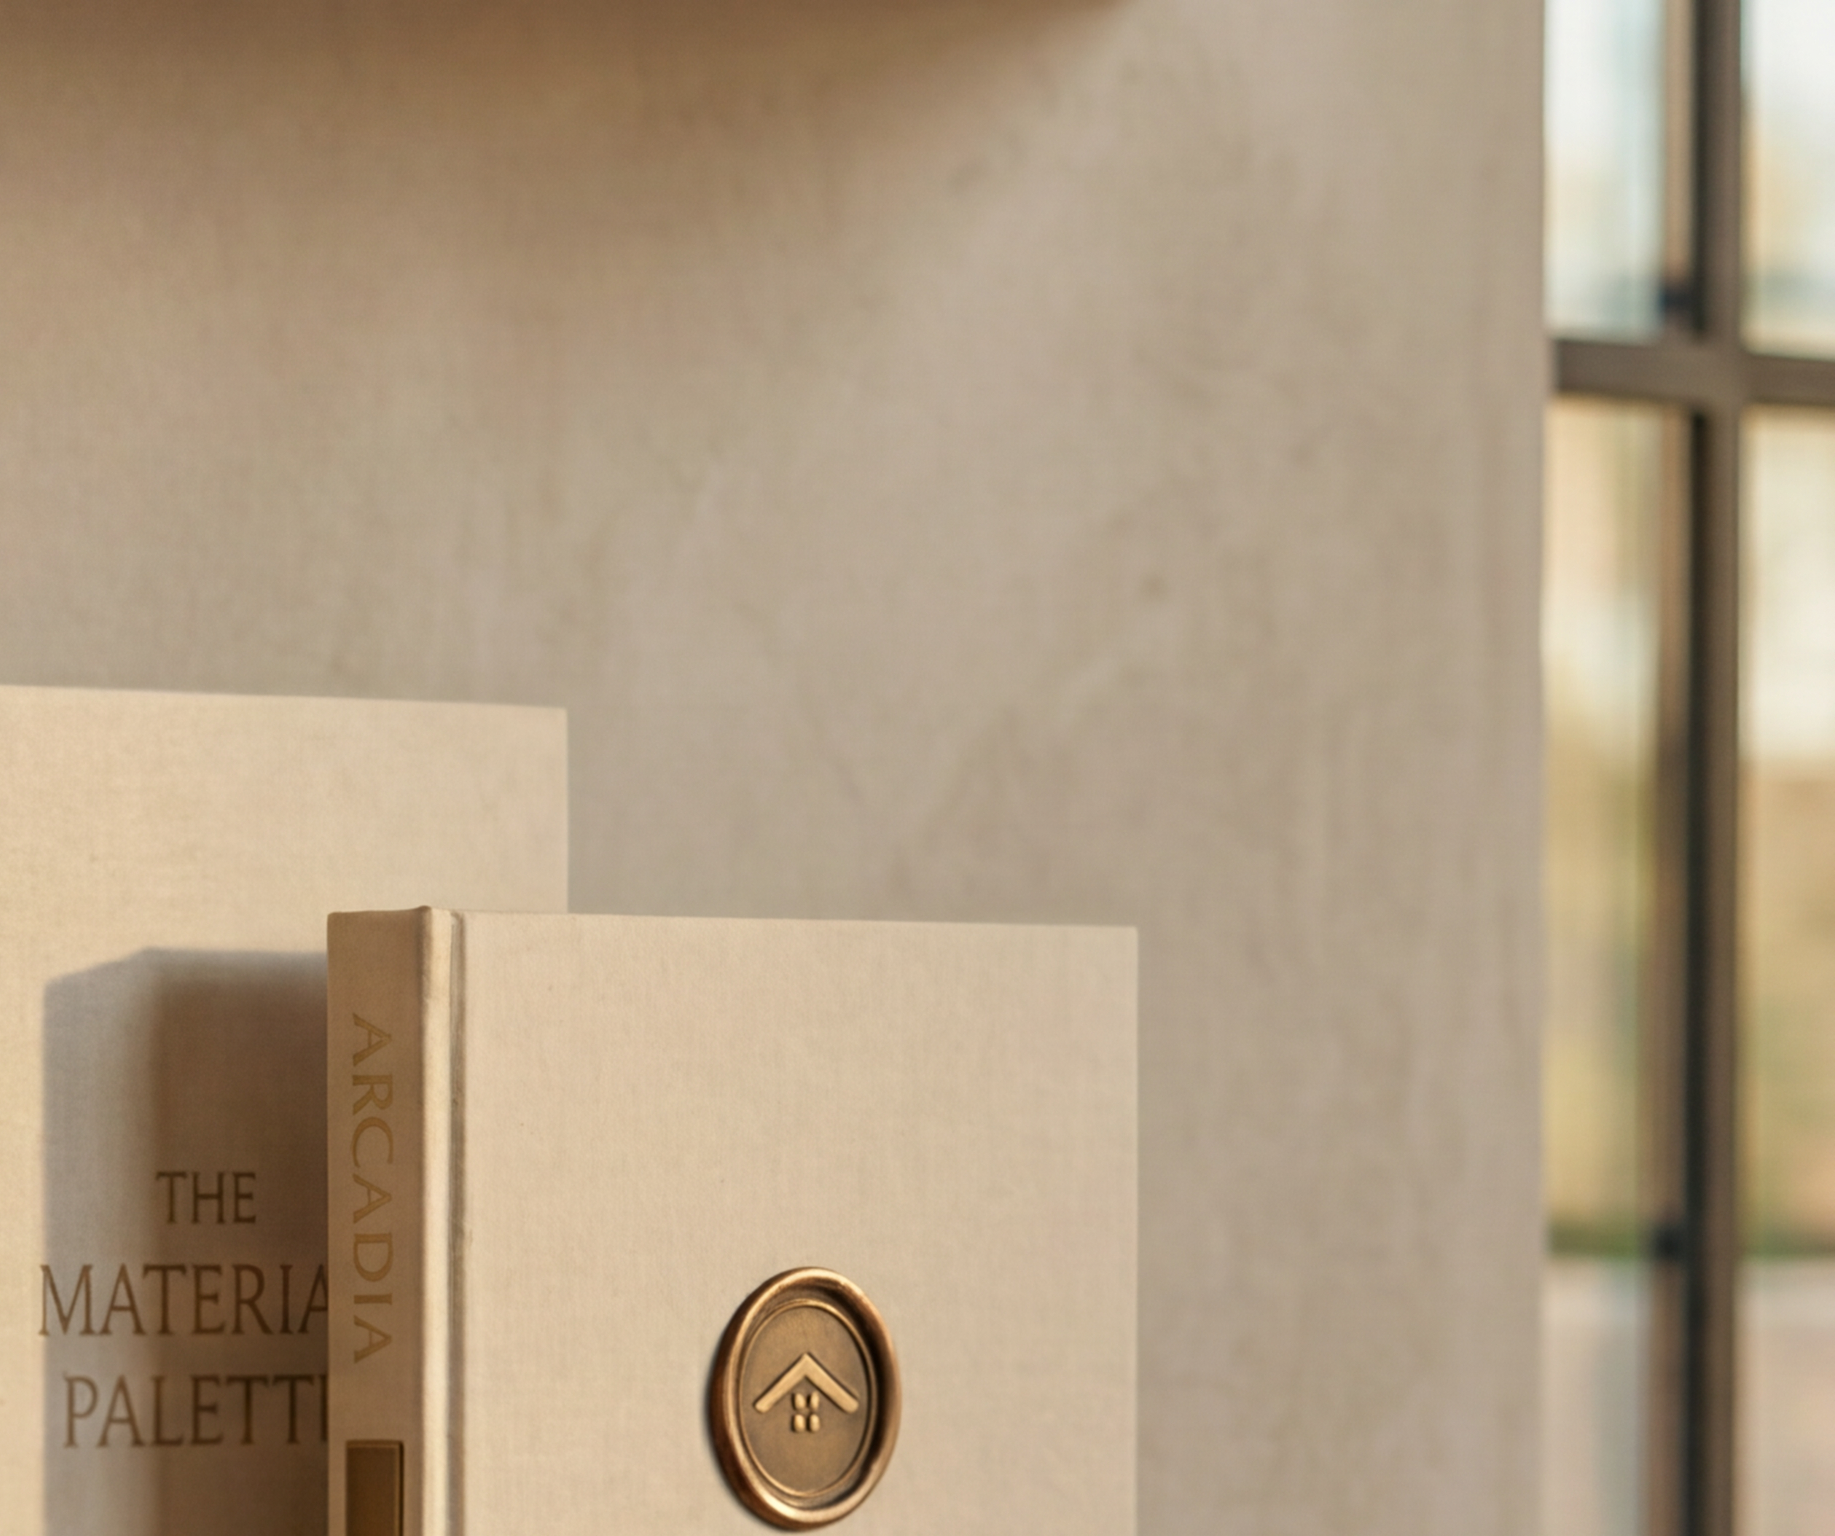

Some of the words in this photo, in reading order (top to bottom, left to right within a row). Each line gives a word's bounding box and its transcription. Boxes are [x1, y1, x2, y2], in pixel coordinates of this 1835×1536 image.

[156, 1171, 257, 1224] THE
[351, 1012, 395, 1365] ARCADIA
[39, 1263, 328, 1335] MATERIA
